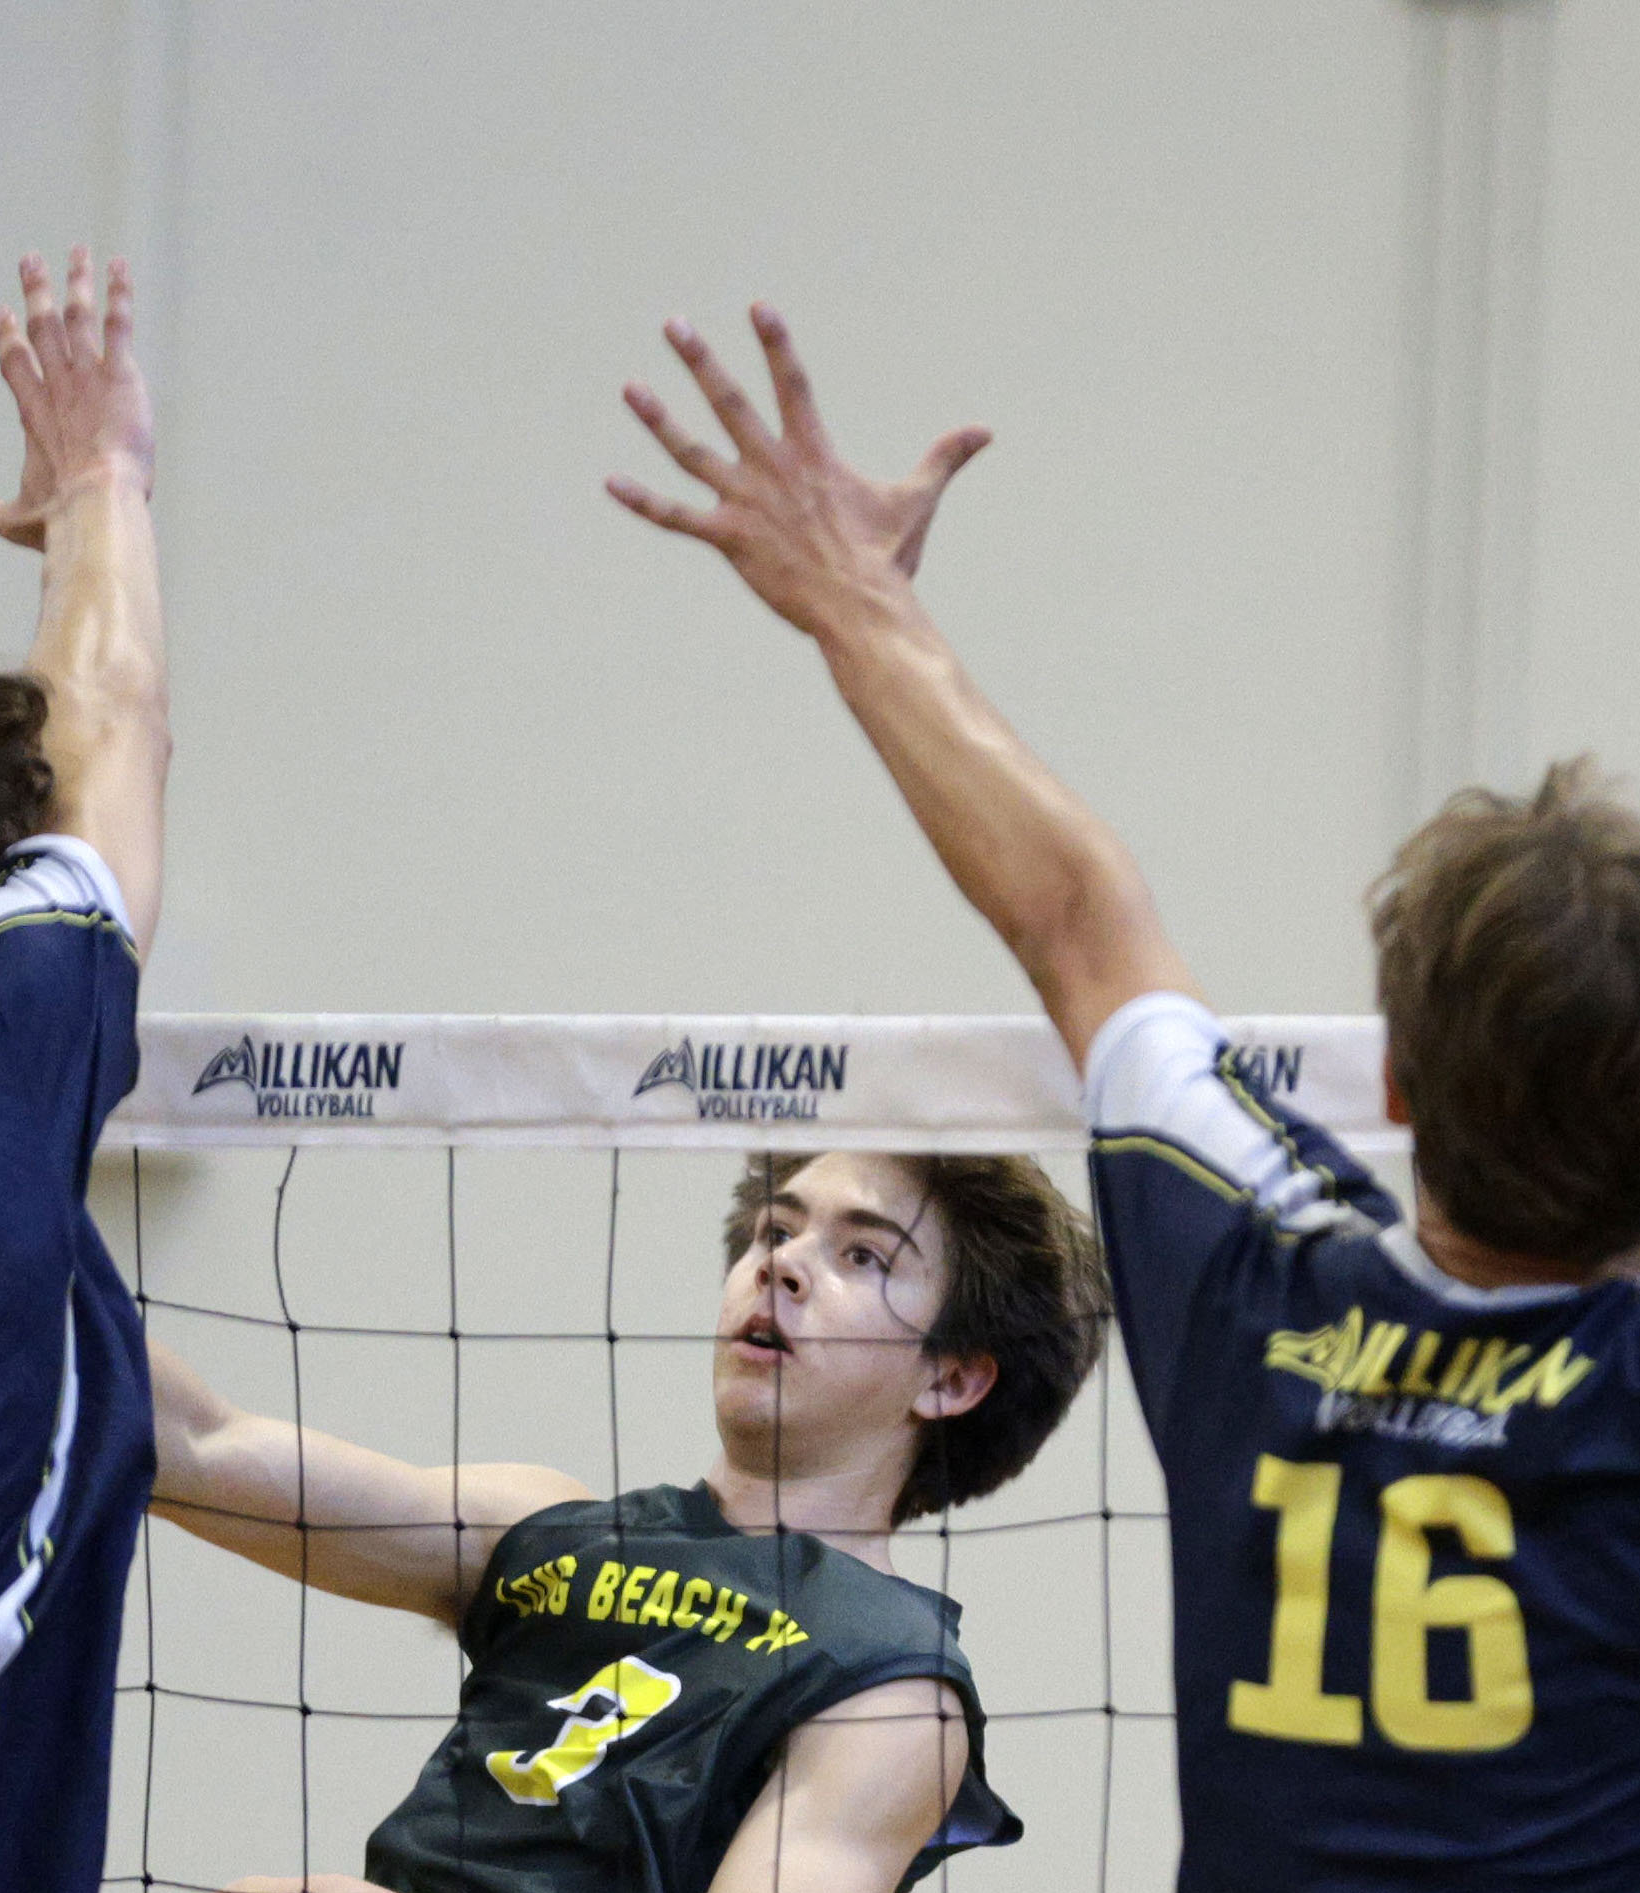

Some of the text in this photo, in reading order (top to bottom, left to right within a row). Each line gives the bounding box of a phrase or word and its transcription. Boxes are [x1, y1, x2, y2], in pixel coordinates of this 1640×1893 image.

[192, 1033, 405, 1095] MILLIKAN
[632, 1035, 849, 1097] MILLIKAN
[257, 1093, 375, 1118] VOLLEYBALL
[697, 1095, 819, 1119] VOLLEYBALL
[1263, 1305, 1597, 1413] MILLIKN
[586, 1560, 749, 1643] BEACH
[1227, 1452, 1535, 1752] 16
